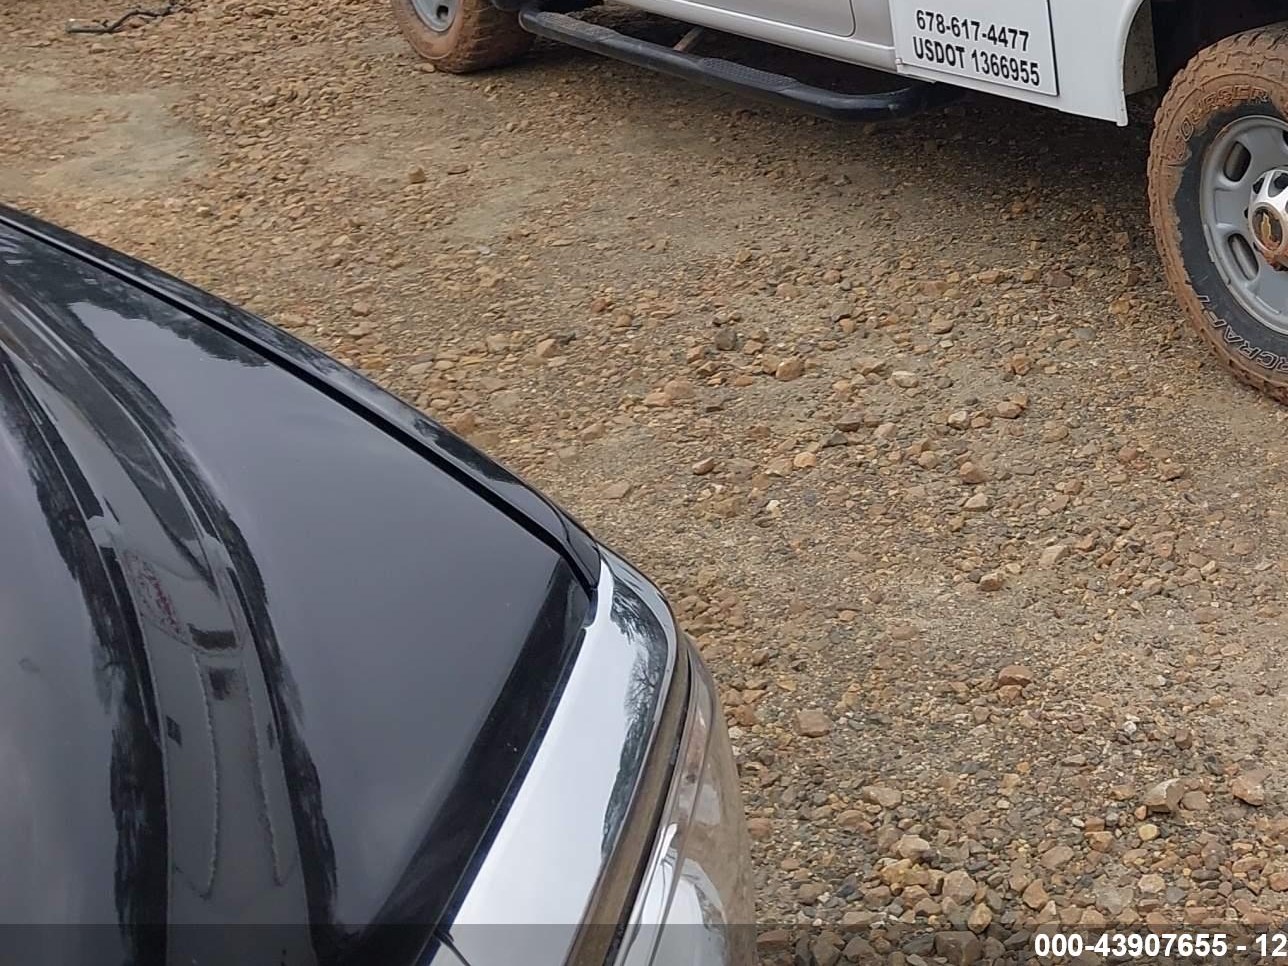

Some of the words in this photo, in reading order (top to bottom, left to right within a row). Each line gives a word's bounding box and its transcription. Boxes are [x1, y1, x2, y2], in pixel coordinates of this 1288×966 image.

[916, 9, 1029, 52] 678-617-4477
[913, 36, 965, 69] USDOT
[971, 49, 1040, 86] 1366955
